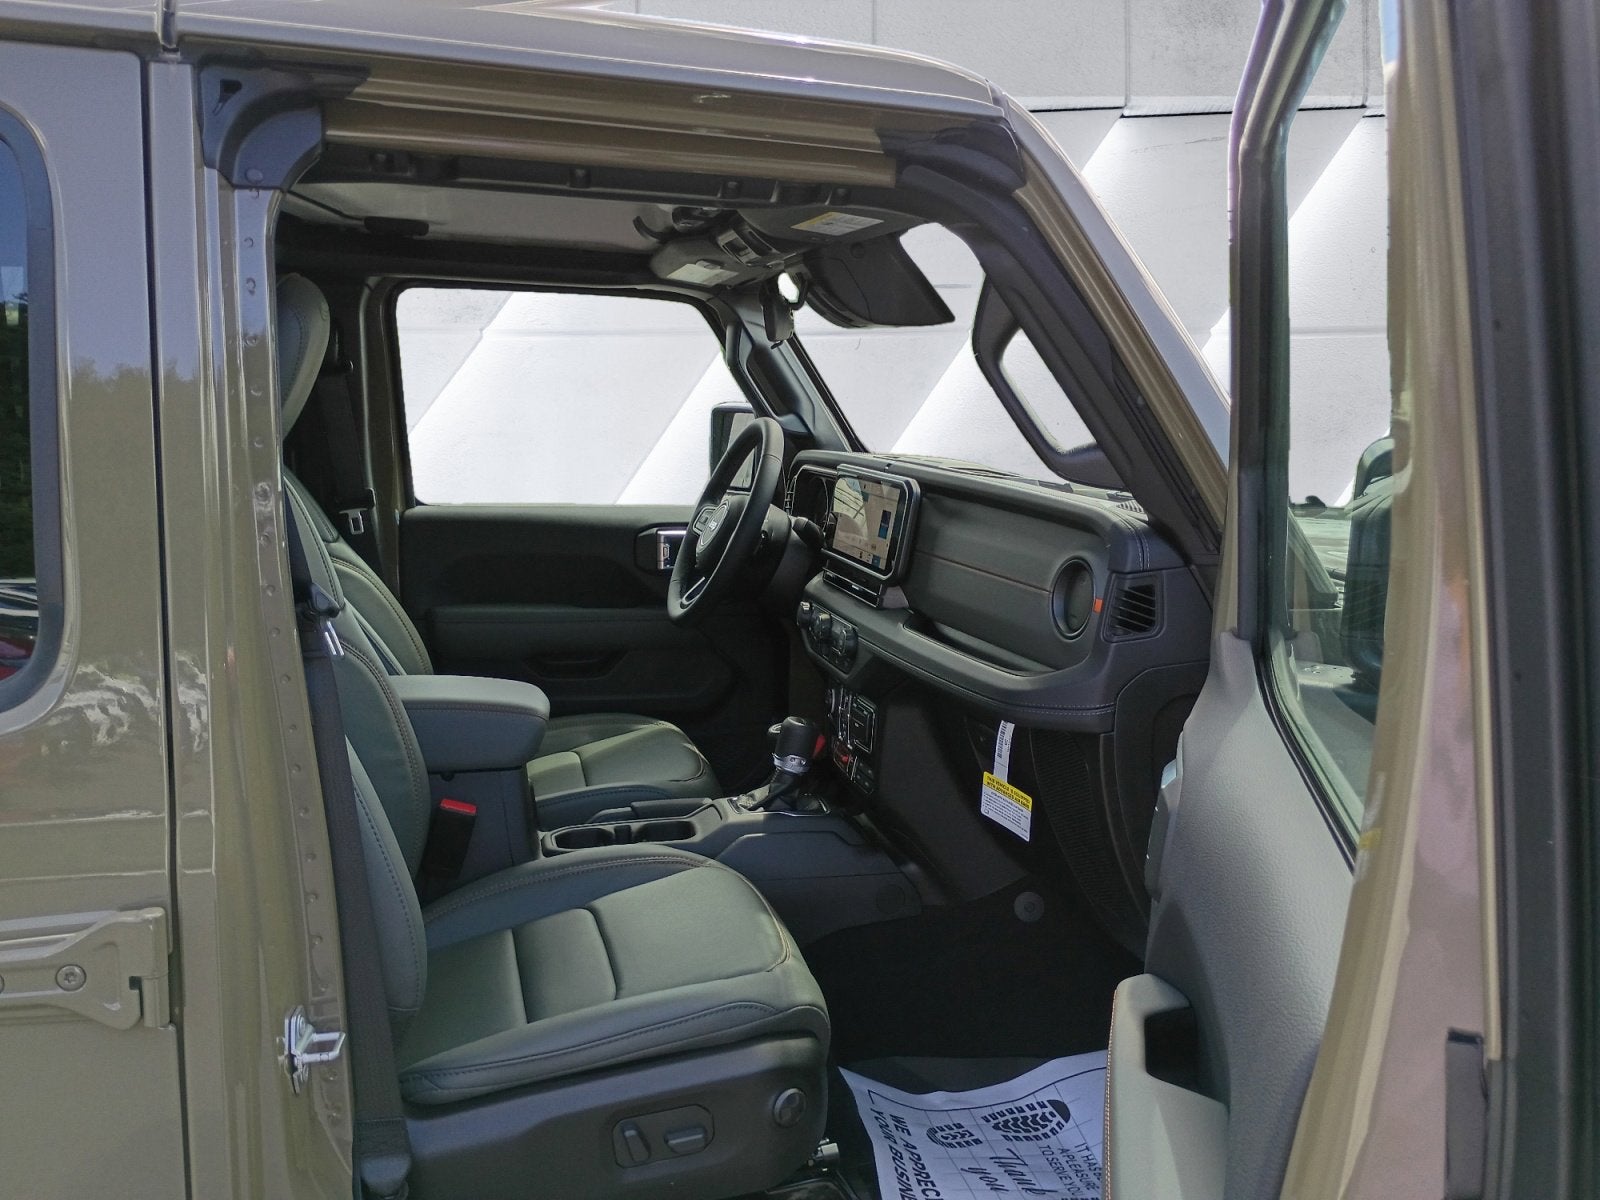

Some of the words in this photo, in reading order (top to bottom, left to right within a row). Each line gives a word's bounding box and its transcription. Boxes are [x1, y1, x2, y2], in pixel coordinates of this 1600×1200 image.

[870, 1108, 898, 1145] YOUR
[889, 1113, 912, 1137] WE
[960, 1167, 1010, 1192] you
[988, 1148, 1059, 1196] Thank
